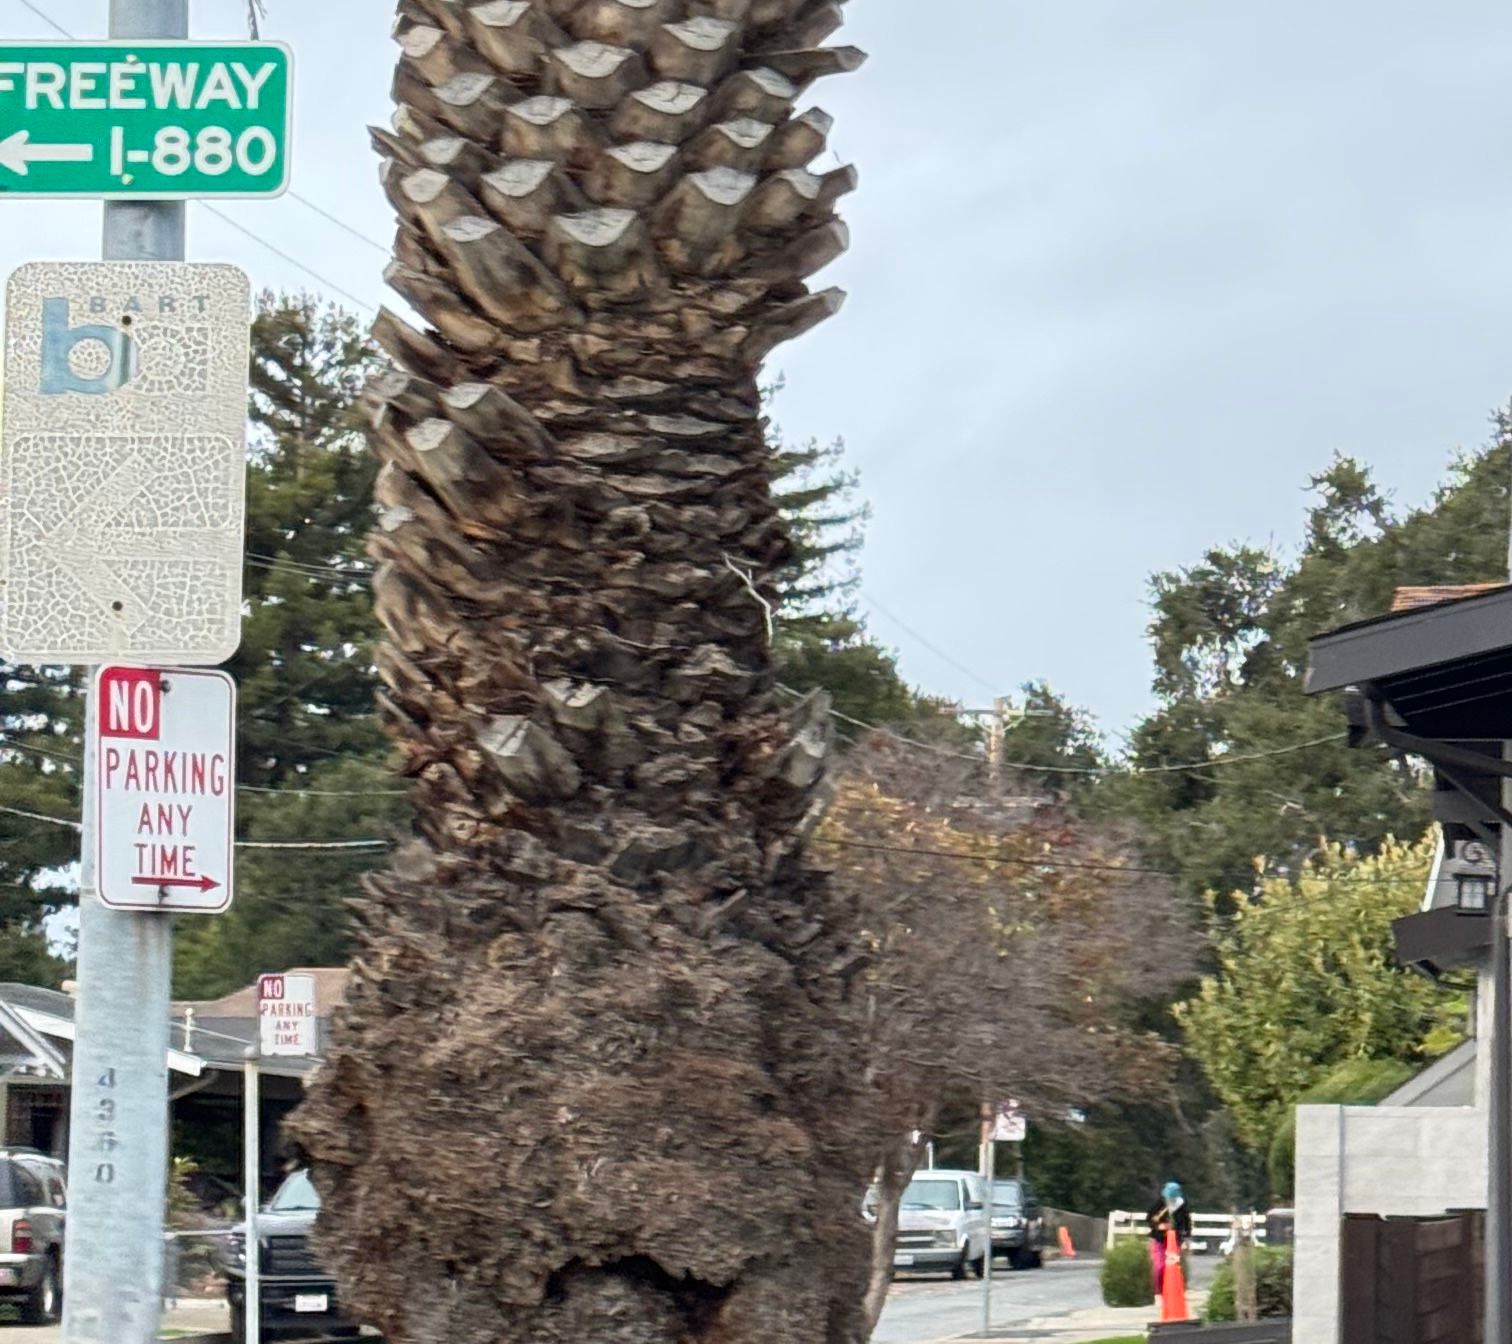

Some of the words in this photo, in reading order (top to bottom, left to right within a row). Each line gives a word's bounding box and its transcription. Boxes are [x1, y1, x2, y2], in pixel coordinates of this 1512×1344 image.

[110, 126, 277, 176] I-880
[90, 295, 210, 313] BART
[109, 680, 154, 733] NO
[106, 748, 224, 796] PARKING
[138, 803, 192, 837] ANY
[134, 843, 196, 877] TIME
[263, 979, 283, 998] NO
[261, 1003, 312, 1017] PARKING
[276, 1021, 299, 1031] ANY
[274, 1034, 301, 1046] TIME
